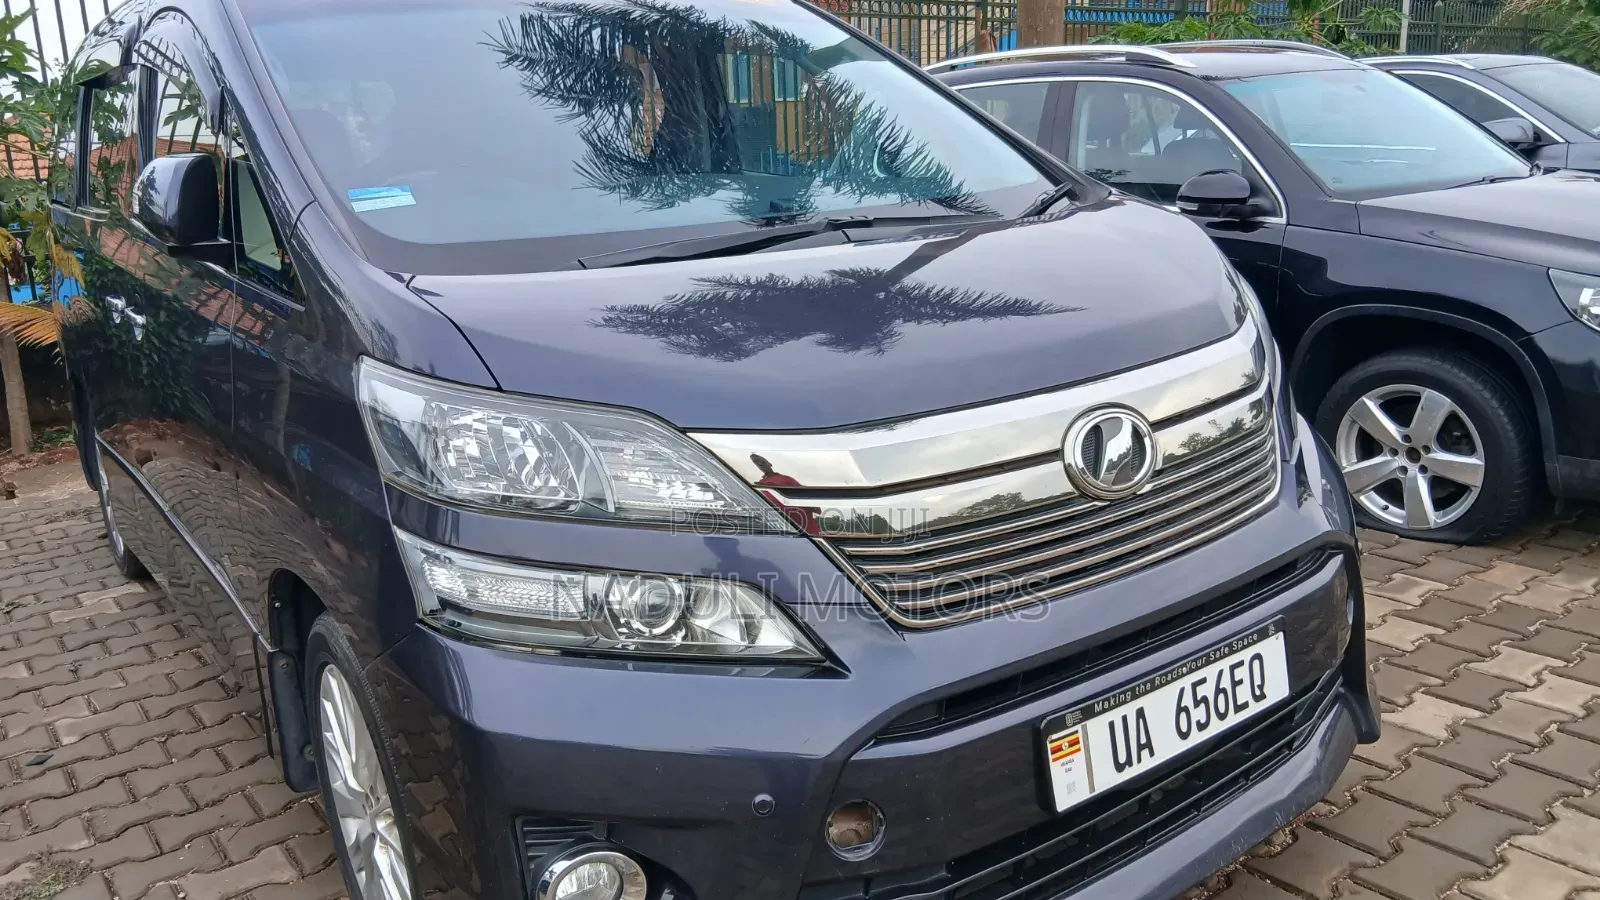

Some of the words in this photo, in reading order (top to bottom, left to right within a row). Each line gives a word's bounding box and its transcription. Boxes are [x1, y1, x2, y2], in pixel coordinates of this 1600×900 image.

[1094, 691, 1132, 714] Making
[1135, 681, 1151, 695] the
[1155, 667, 1183, 687] Roads
[1185, 656, 1207, 673] Your
[1209, 645, 1229, 661] Safe
[1232, 632, 1259, 651] Space
[1108, 706, 1155, 774] UA
[1174, 652, 1267, 741] 656EQ
